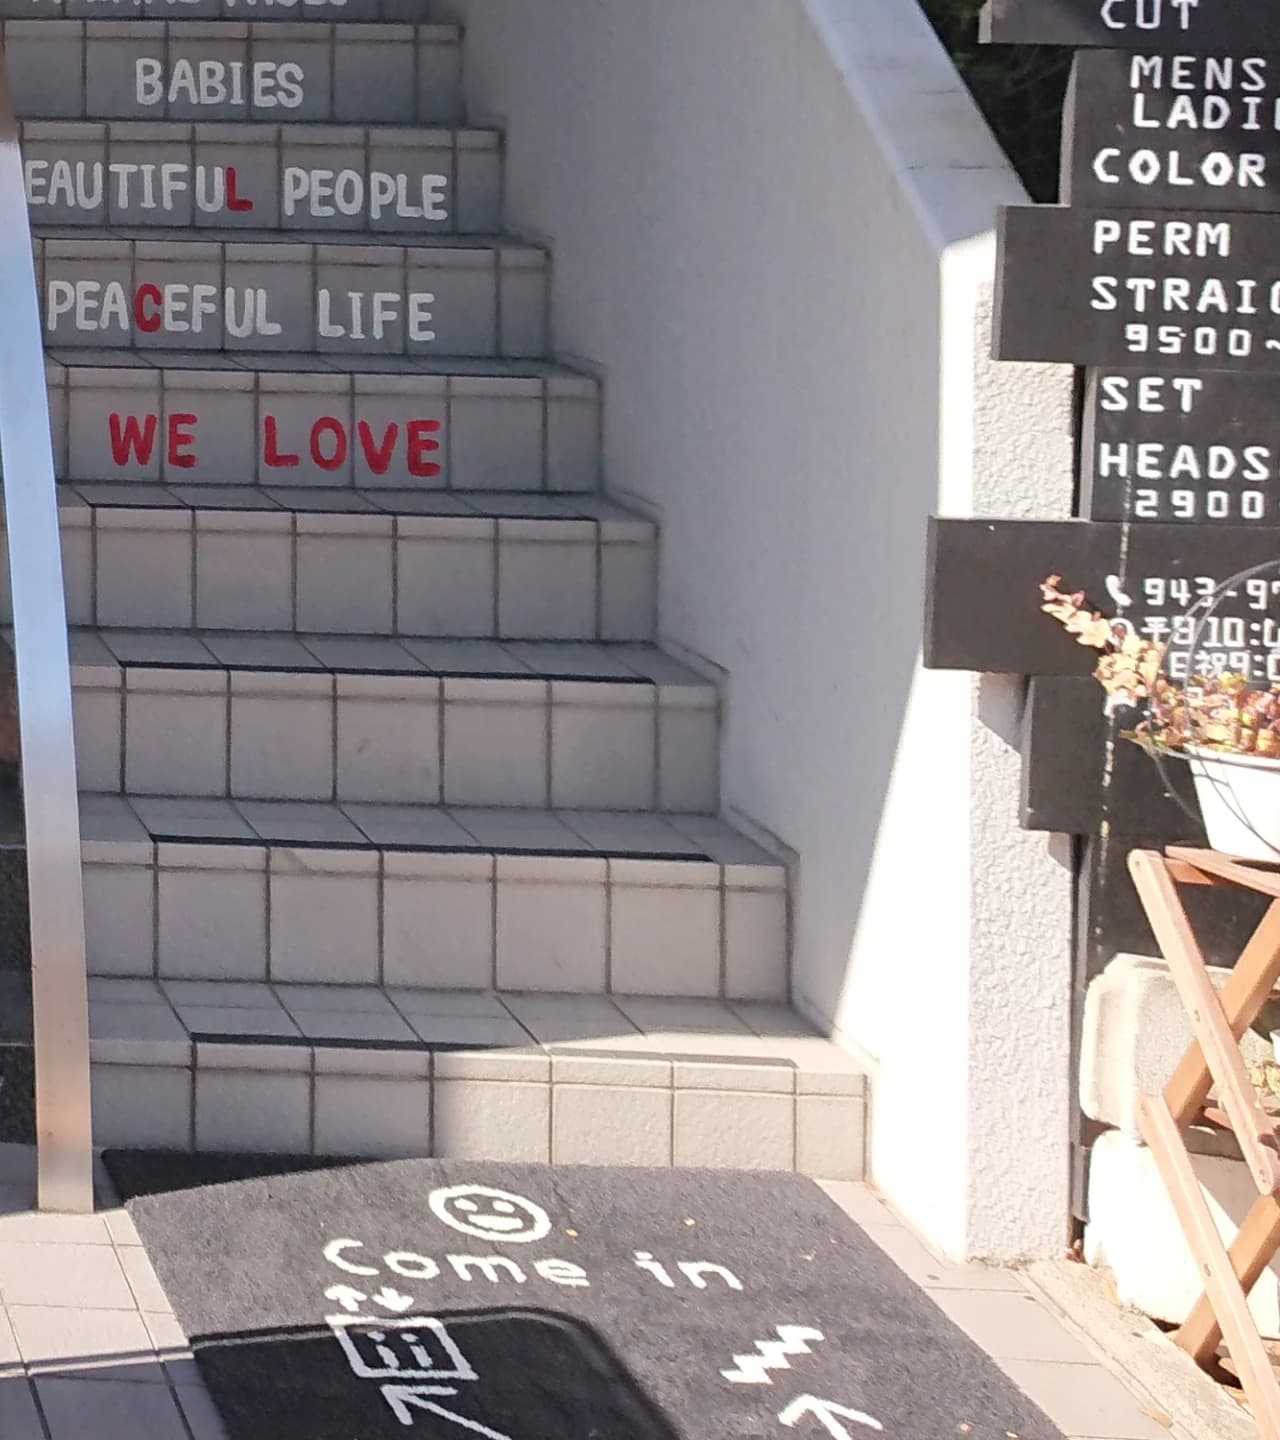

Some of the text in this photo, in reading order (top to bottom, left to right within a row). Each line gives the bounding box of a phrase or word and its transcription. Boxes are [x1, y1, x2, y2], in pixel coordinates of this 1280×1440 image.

[136, 57, 305, 108] BABIES
[1129, 54, 1267, 92] MENS
[25, 160, 448, 221] EAUTIFUL PEOPLE
[1092, 147, 1267, 188] COLOR
[1093, 219, 1231, 257] PERM
[47, 280, 436, 342] PEACEFUL LIFE
[1099, 376, 1204, 413] SET
[108, 412, 441, 478] WE LOVE
[1098, 441, 1271, 482] HEADS
[322, 1236, 745, 1293] Come in
